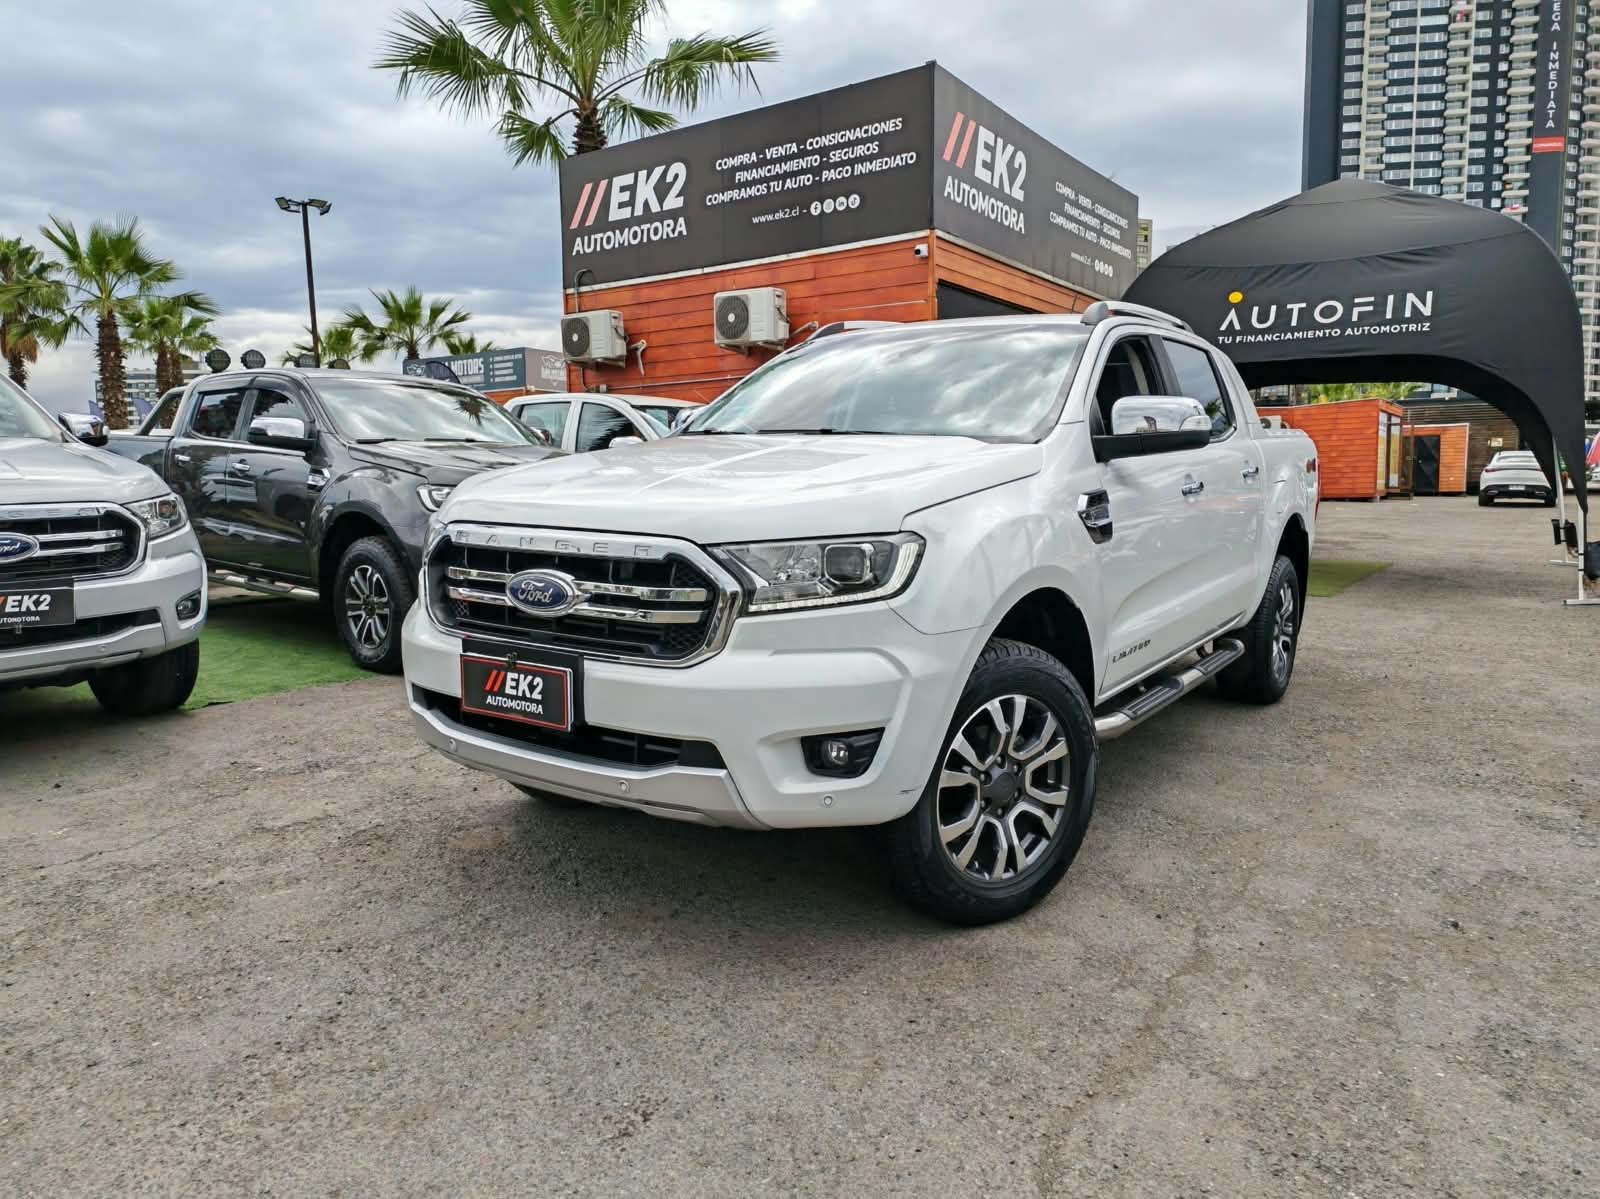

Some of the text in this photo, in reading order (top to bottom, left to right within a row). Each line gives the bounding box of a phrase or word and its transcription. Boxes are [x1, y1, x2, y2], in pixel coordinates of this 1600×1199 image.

[1550, 0, 1561, 32] EGA
[1545, 41, 1560, 129] INMEDIATA
[715, 151, 757, 171] COMPRA
[765, 142, 798, 160] VENTA
[806, 117, 903, 151] CONSIGNACIONES
[735, 154, 820, 183] FINANCIAMIENTO
[829, 141, 879, 163] SEGUROS
[705, 183, 768, 206] COMPRAMOS
[770, 178, 783, 193] TU
[784, 173, 813, 190] AUTO
[821, 166, 852, 183] PAGO
[854, 151, 917, 176] INMEDIATO
[1055, 181, 1076, 200] COMPRA
[752, 206, 800, 224] www.ek2.cl
[944, 175, 1025, 234] AUTOMOTORA
[572, 216, 687, 256] AUTOMOTORA
[1219, 290, 1433, 331] AUTOFIN
[1217, 322, 1431, 344] TU FINANCIAMIENTO AUTOMOTRIZ
[450, 357, 484, 376] MOTORS
[518, 580, 554, 603] Ford
[0, 616, 40, 624] UTOMOTORA
[486, 695, 544, 715] AUTOMOTORA
